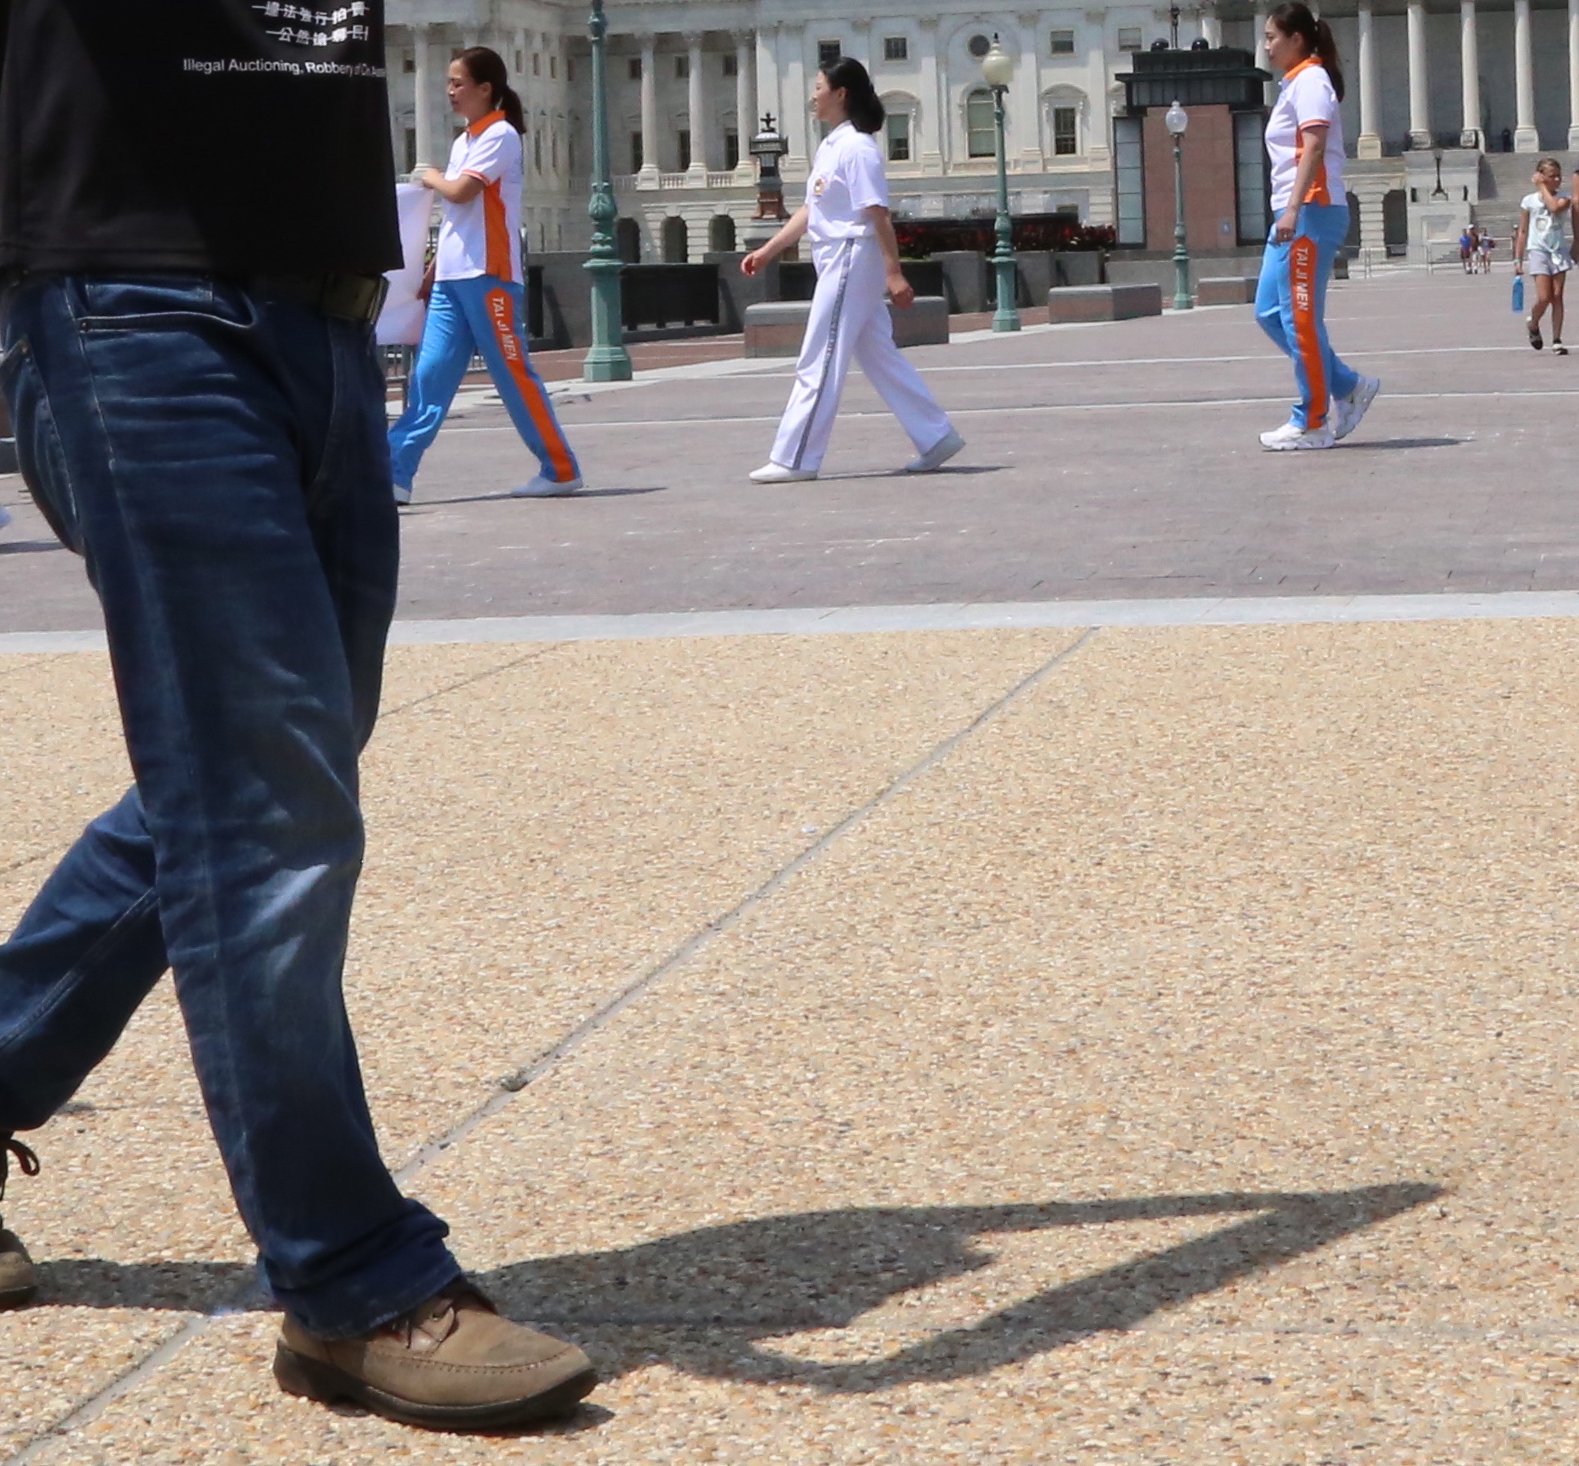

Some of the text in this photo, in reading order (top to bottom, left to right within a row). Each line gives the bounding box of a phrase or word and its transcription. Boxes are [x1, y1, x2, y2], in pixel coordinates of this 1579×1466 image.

[183, 59, 225, 75] Illegal
[1295, 247, 1309, 311] TAI JI MEN
[492, 297, 519, 361] TAI JI MEN
